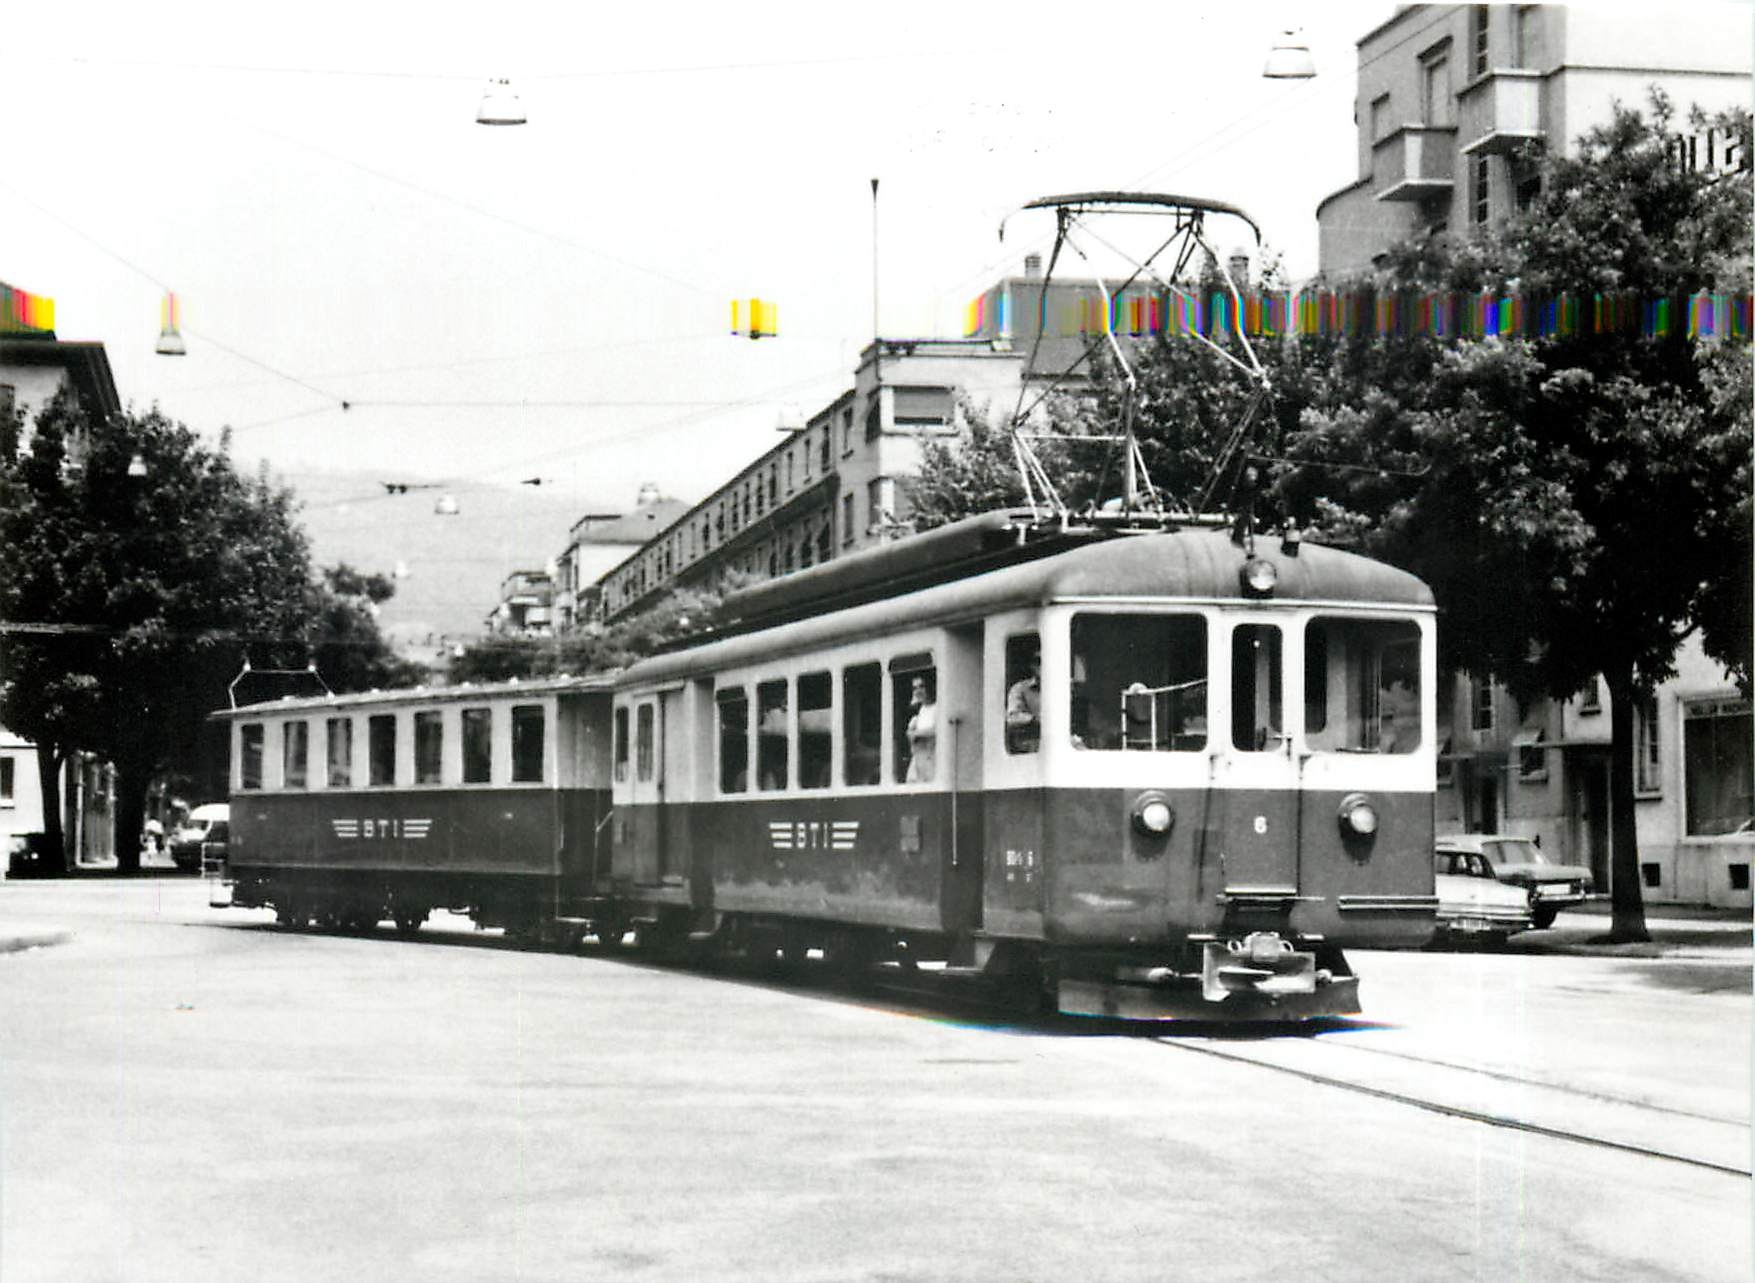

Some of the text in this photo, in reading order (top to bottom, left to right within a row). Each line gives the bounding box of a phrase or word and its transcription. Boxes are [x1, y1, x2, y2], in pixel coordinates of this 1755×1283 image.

[363, 819, 398, 838] BTI
[1254, 816, 1267, 834] 6
[797, 822, 828, 848] BTI
